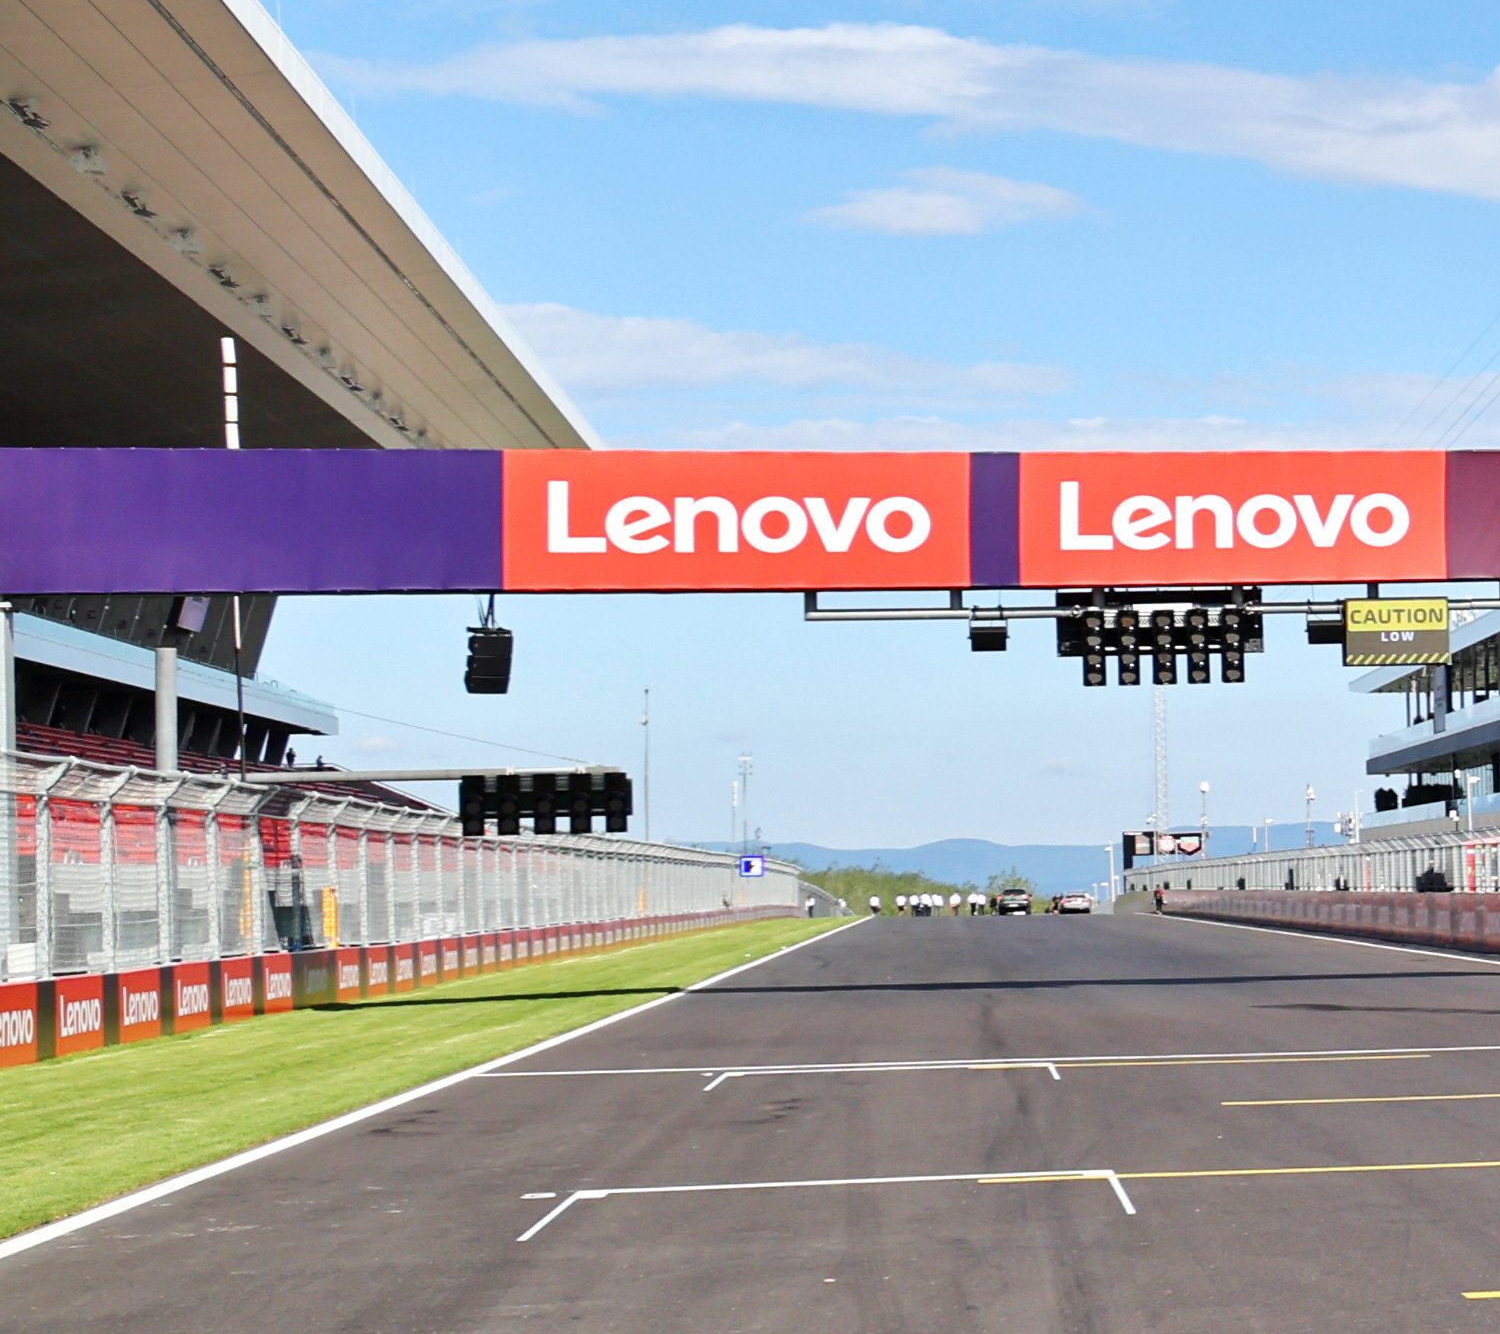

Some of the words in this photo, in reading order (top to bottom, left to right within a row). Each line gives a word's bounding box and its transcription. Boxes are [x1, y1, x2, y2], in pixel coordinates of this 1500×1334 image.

[547, 480, 931, 555] Lenovo
[1059, 480, 1410, 552] Lenovo
[1349, 607, 1444, 626] CAUTION
[1380, 630, 1415, 643] LOW
[224, 972, 252, 1008] Lenovo
[265, 967, 292, 1001] Lenovo
[338, 960, 360, 990] Lenovo
[59, 994, 101, 1038] Lenovo
[122, 986, 159, 1027] Lenovo
[176, 979, 209, 1017] Lenovo
[0, 1008, 34, 1048] novo
